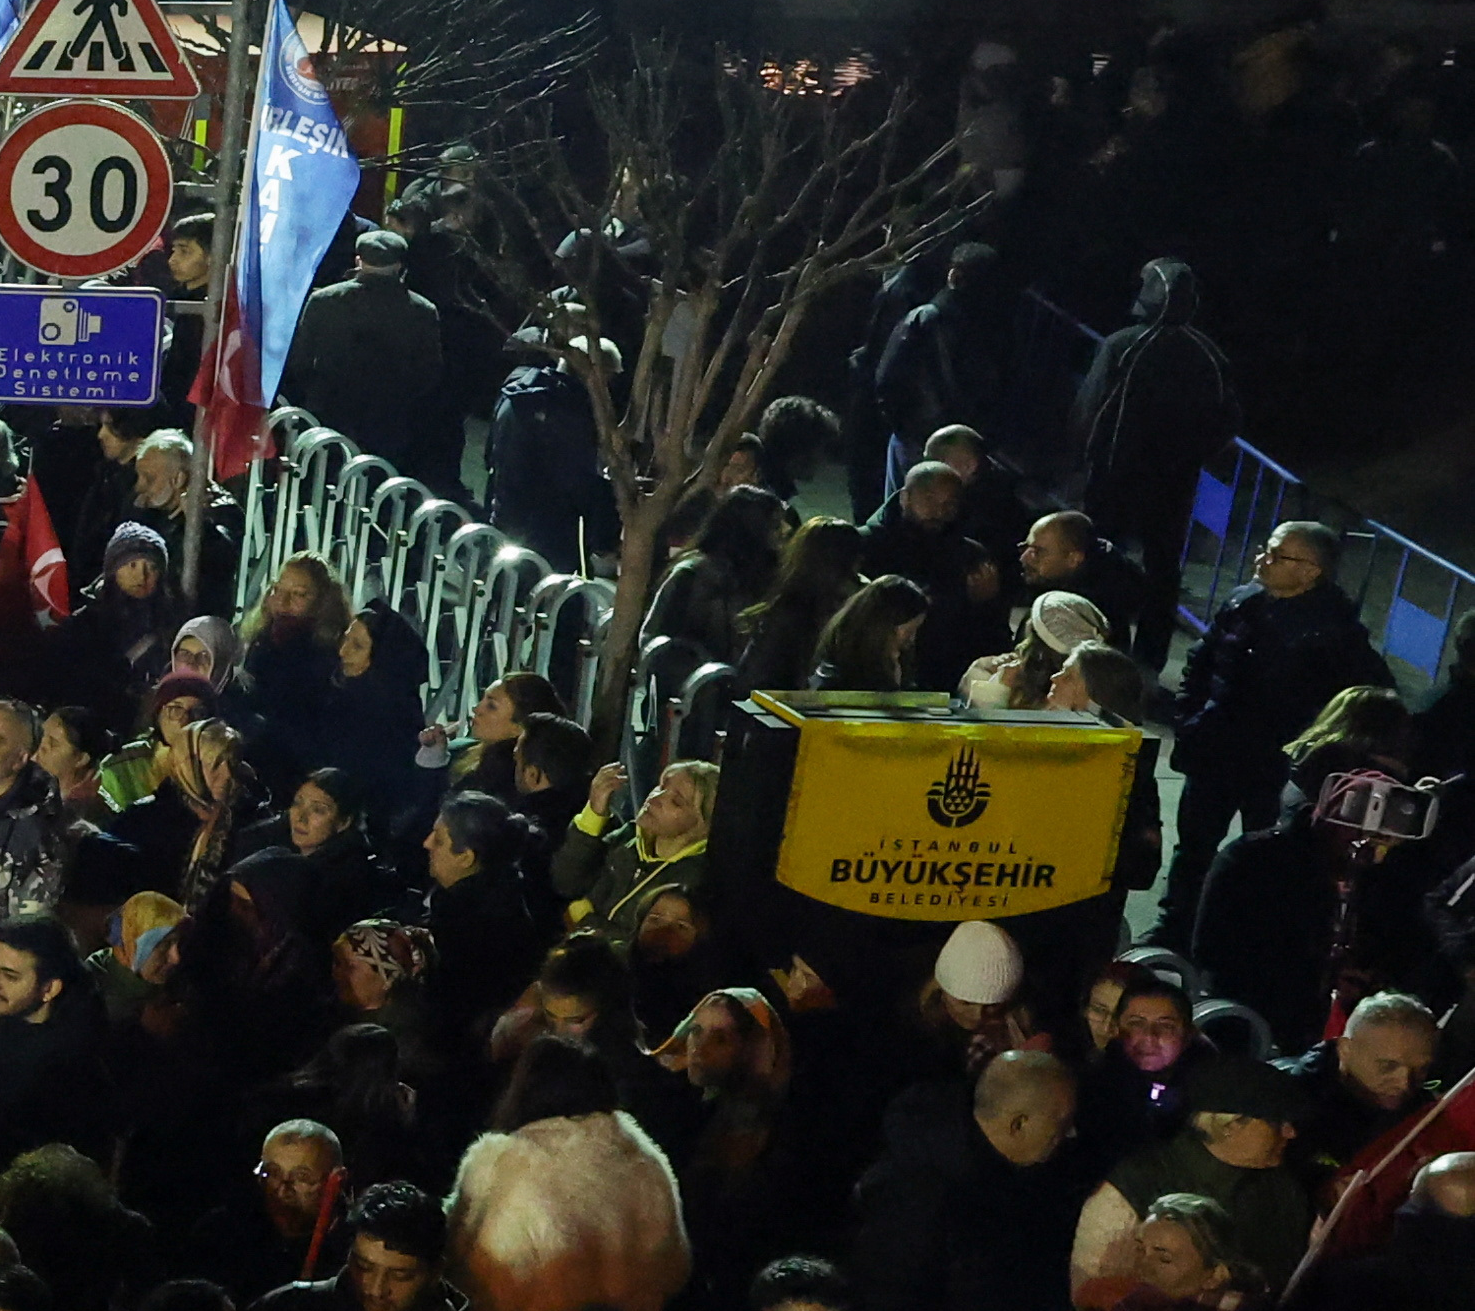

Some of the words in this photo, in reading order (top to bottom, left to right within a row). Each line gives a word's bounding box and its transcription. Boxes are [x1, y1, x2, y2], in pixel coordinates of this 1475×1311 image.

[27, 155, 138, 233] 30
[13, 381, 118, 398] Sistemi
[879, 836, 1018, 855] İSTANBUL
[830, 851, 1056, 893] BÜYÜKŞEHİR
[869, 890, 1010, 908] BELEDİYESİ
